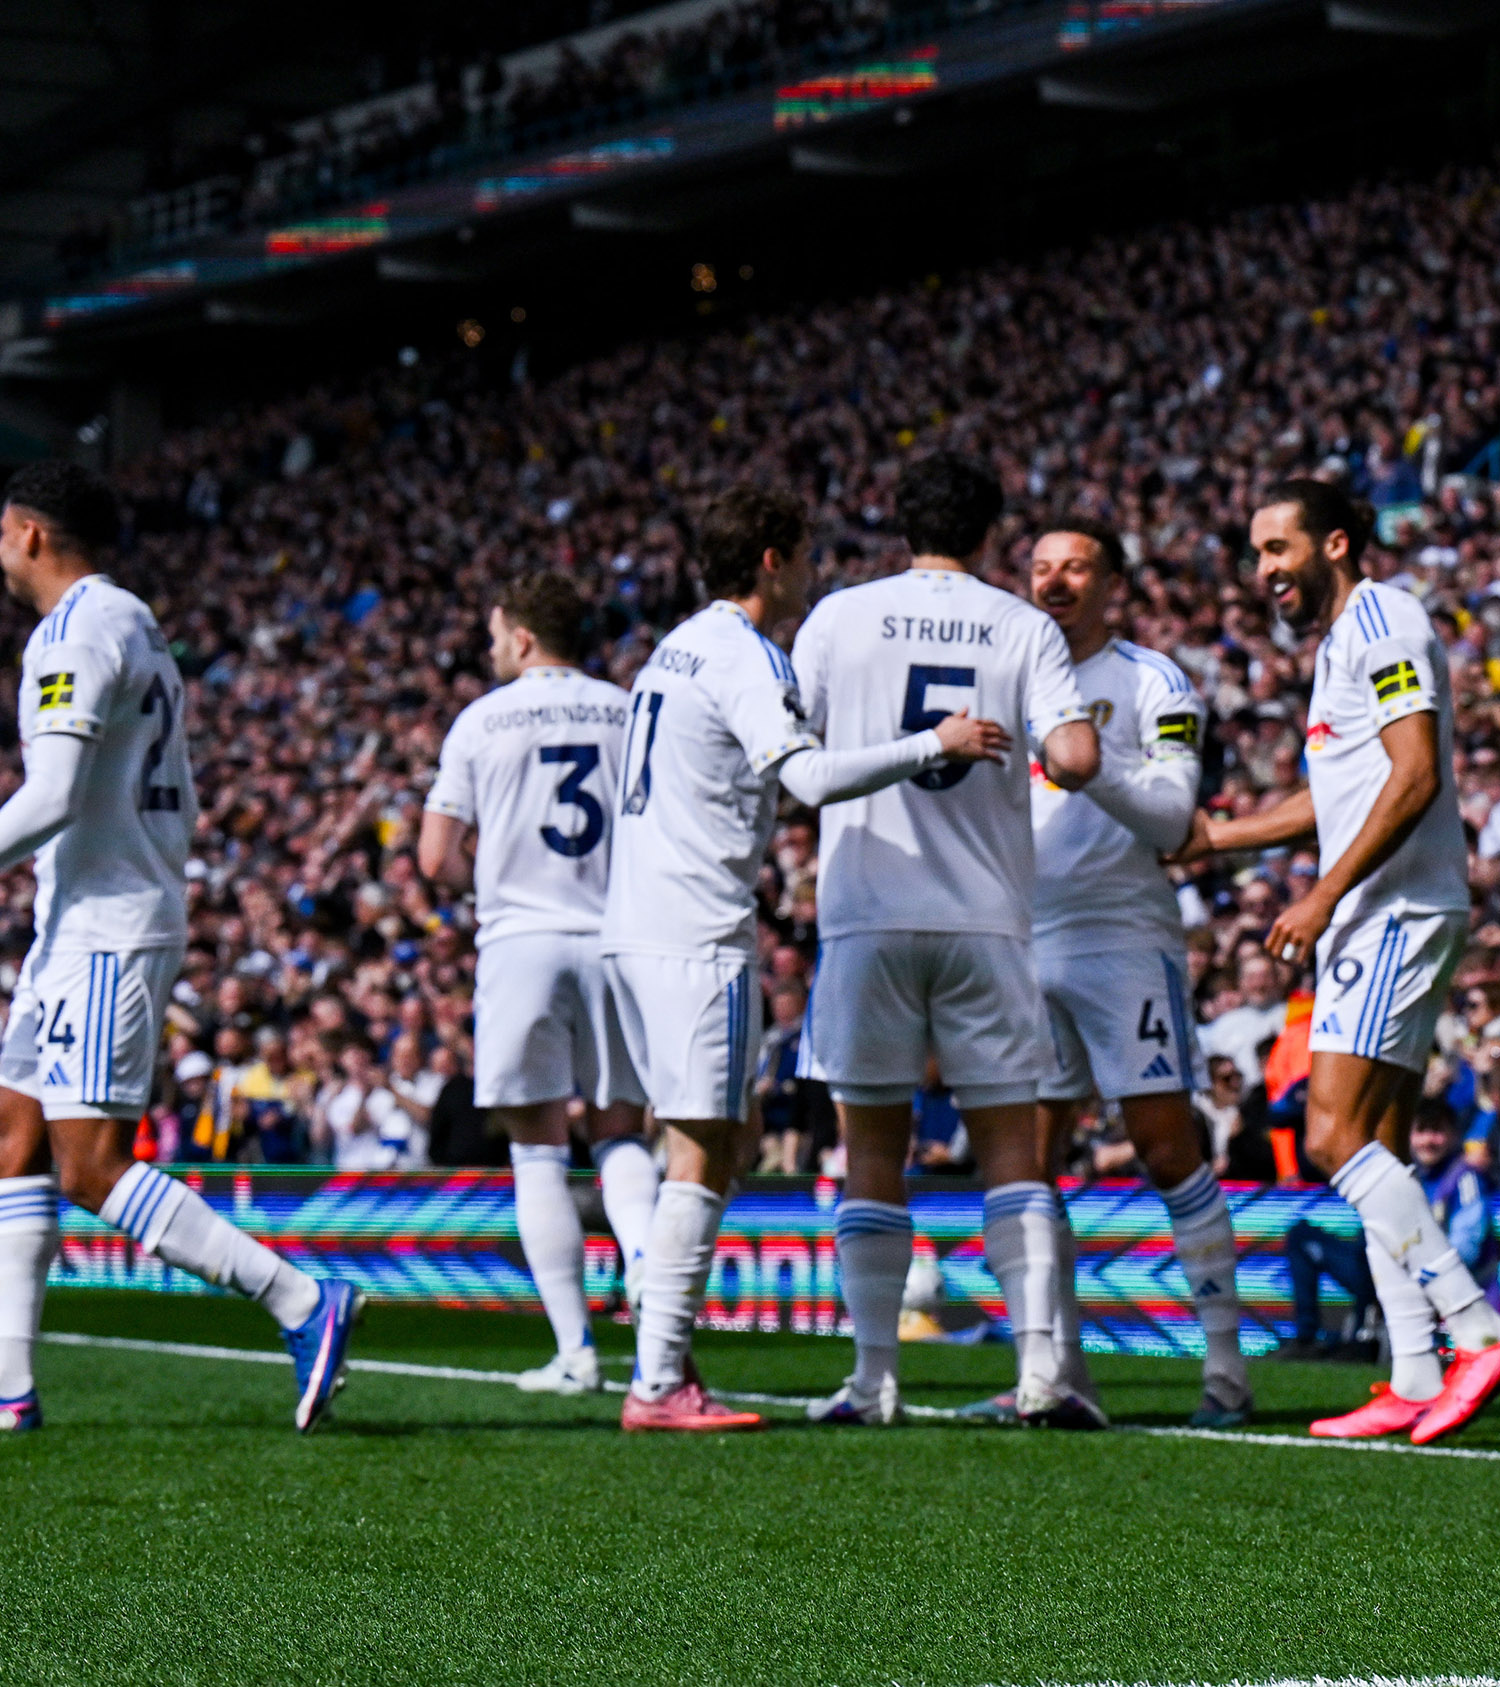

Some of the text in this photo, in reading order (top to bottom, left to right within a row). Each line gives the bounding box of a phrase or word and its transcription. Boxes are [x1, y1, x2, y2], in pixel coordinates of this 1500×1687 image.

[881, 616, 993, 646] STRUIJK
[139, 672, 181, 811] 2
[483, 703, 625, 734] GUDMUNDSSO
[902, 663, 975, 791] 5
[539, 744, 603, 858] 3
[1332, 957, 1363, 1003] 9
[1139, 999, 1168, 1048] 4
